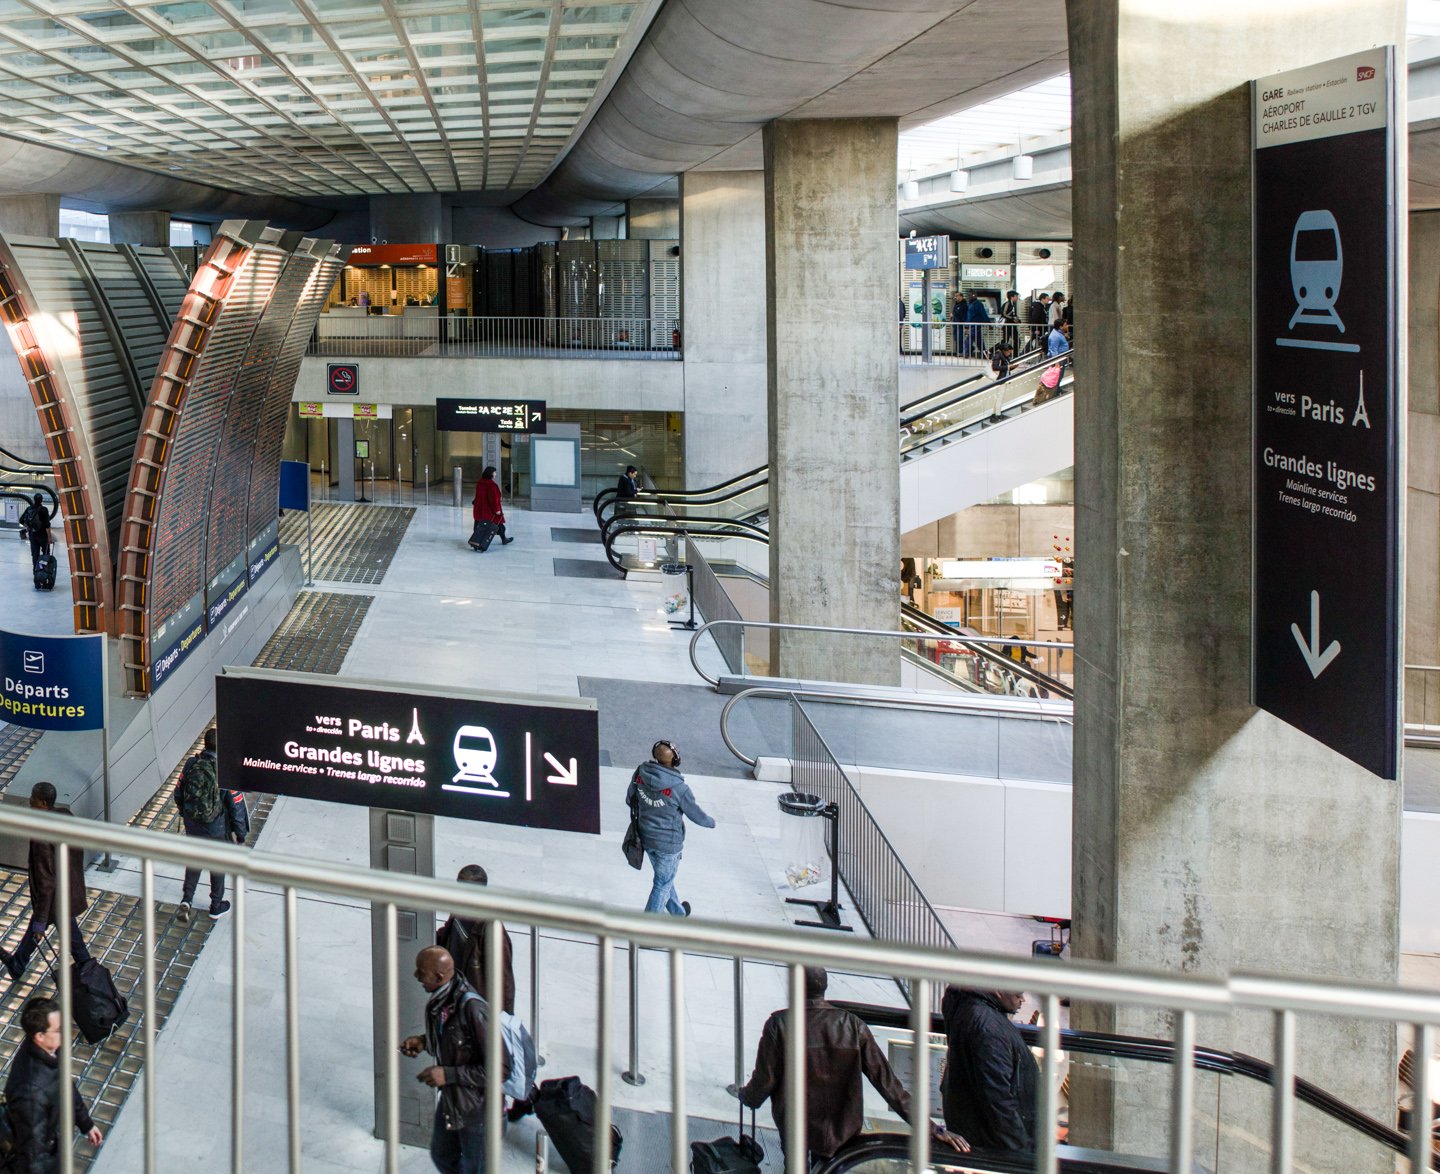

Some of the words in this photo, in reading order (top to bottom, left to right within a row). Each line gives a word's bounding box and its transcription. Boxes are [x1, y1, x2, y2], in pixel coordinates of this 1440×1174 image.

[1357, 69, 1375, 80] SNCF
[1262, 88, 1284, 102] GARE
[1287, 88, 1305, 97] Railway
[1306, 83, 1322, 93] station
[1326, 77, 1348, 88] Estación
[1262, 100, 1305, 119] AÉROPORT
[1262, 118, 1298, 134] CHARLES
[1300, 115, 1311, 127] DE
[1313, 107, 1347, 125] GAULLE
[1349, 106, 1355, 118] 2
[1357, 102, 1377, 116] TGV
[478, 406, 490, 415] 2A
[490, 406, 502, 415] 2C
[502, 406, 513, 415] 2E
[1274, 391, 1296, 404] vers
[1301, 395, 1345, 425] Paris
[1263, 447, 1323, 479] Grandes
[1327, 460, 1376, 492] lignes
[1285, 478, 1317, 497] Mainline
[1318, 488, 1348, 505] services
[1278, 491, 1301, 507] Trenes
[1301, 497, 1321, 514] largo
[1322, 505, 1357, 523] recorrido
[161, 648, 179, 672] Départs
[180, 624, 202, 652] Departures
[5, 677, 70, 699] Départs
[315, 715, 343, 727] vers
[348, 718, 400, 742] Paris
[284, 741, 363, 766] Grandes
[367, 750, 426, 773] lignes
[242, 757, 281, 771] Mainline
[282, 763, 318, 775] services
[326, 767, 357, 780] Trenes
[357, 770, 382, 784] largo
[383, 776, 427, 788] recorrido
